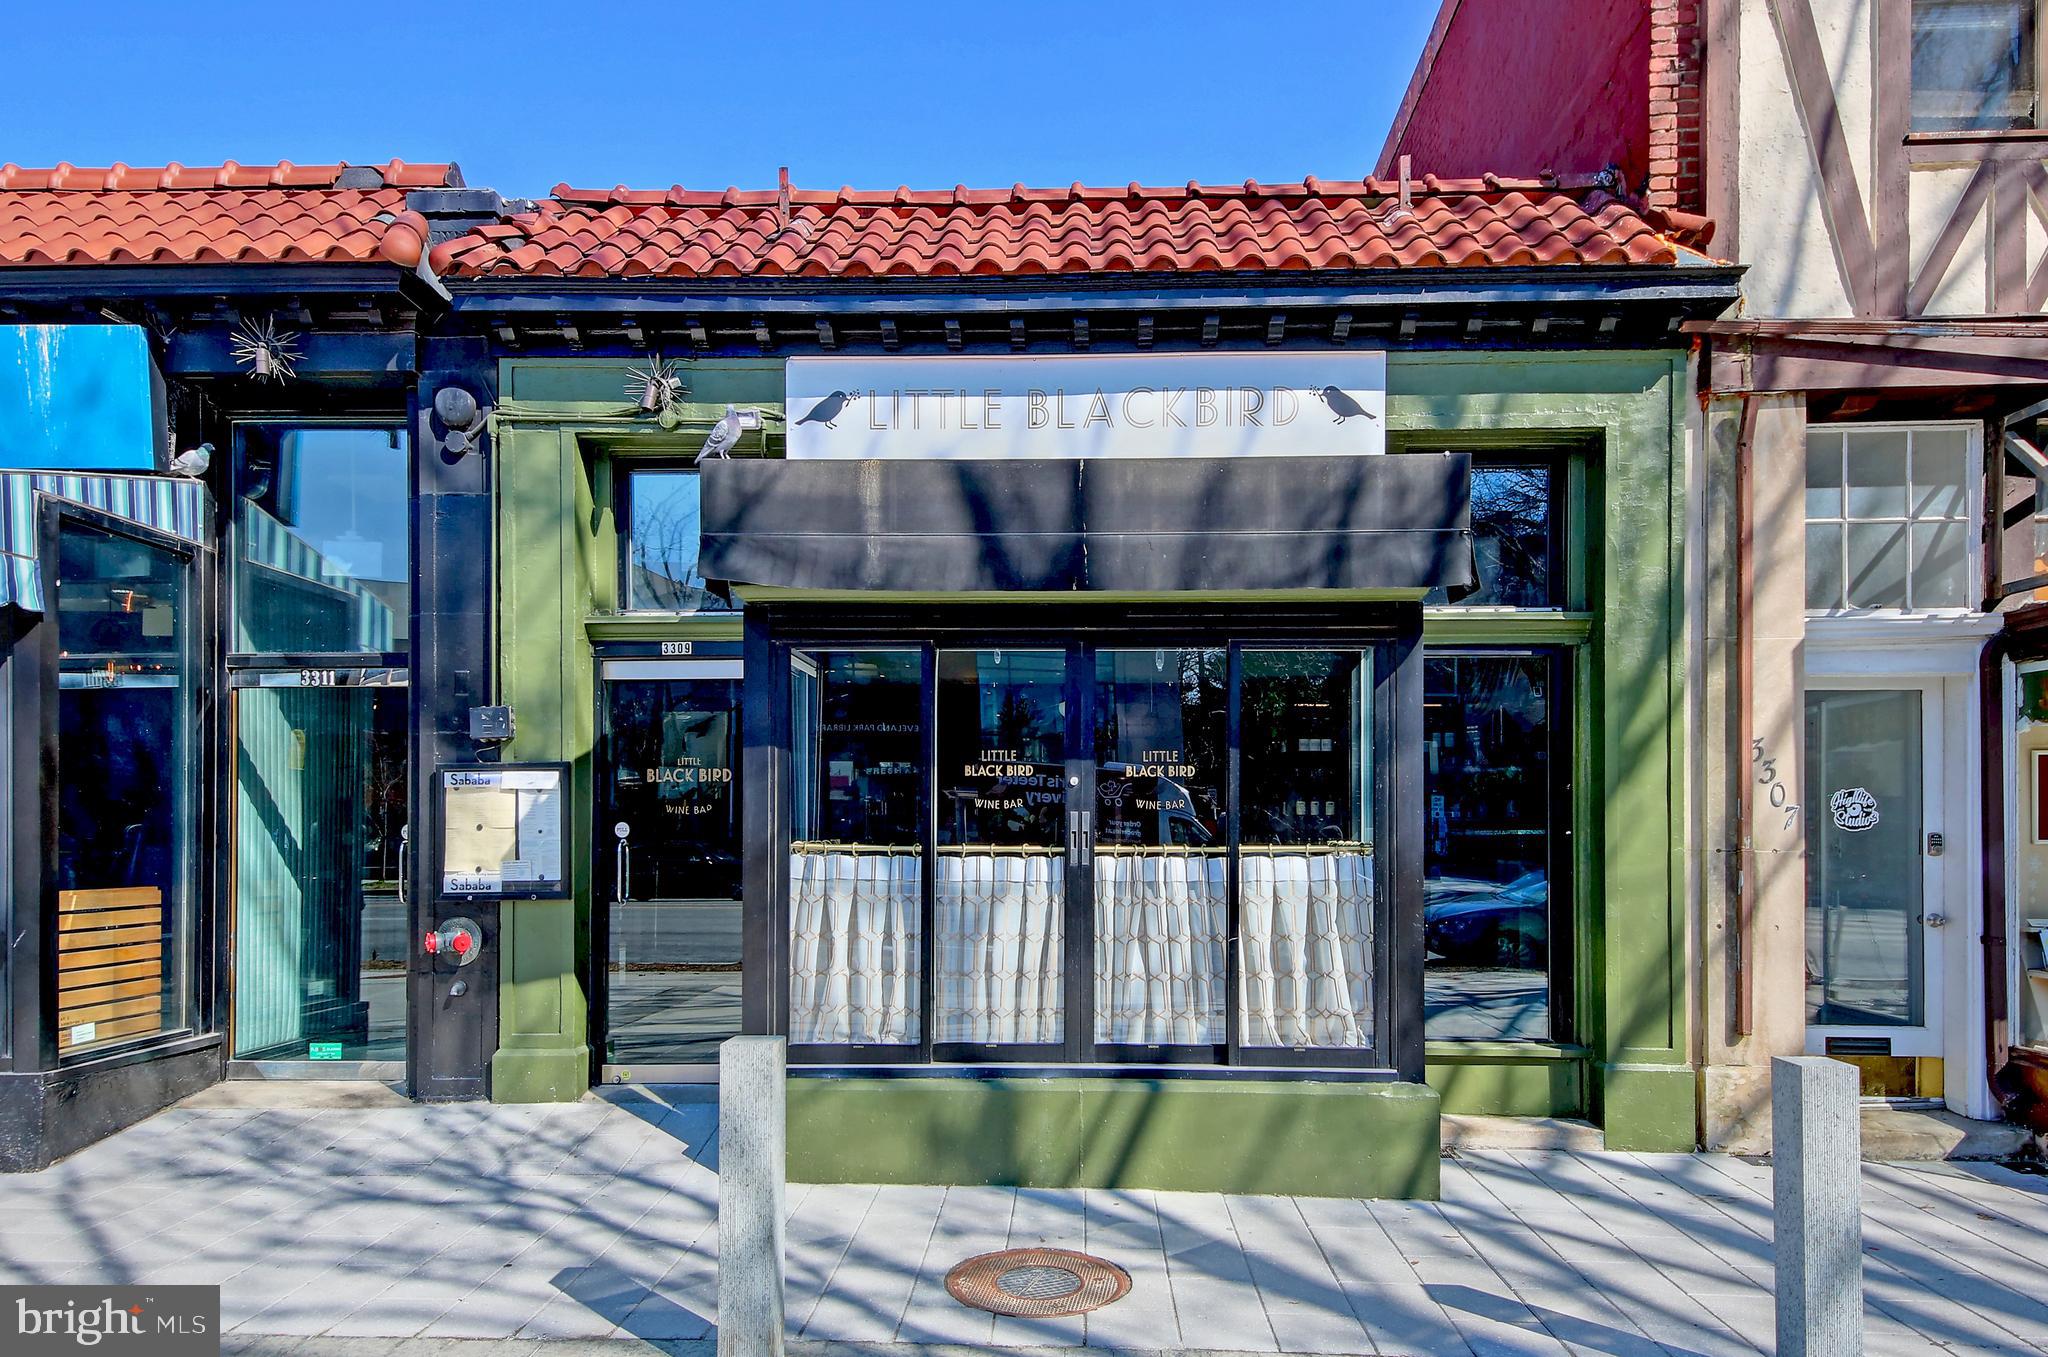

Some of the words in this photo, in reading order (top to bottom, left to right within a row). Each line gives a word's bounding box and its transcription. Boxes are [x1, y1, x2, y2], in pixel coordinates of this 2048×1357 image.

[869, 388, 1002, 430] LITTLE
[1027, 385, 1300, 430] BLACKBIRD
[663, 643, 690, 654] 3309
[301, 669, 336, 687] 3311
[677, 757, 701, 766] LITTLE
[981, 750, 1017, 762] LITTLE
[1142, 750, 1178, 763] LITTLE
[646, 768, 695, 782] BLACK
[698, 768, 732, 782] BIRD
[964, 765, 1002, 777] BLACK
[1006, 765, 1034, 777] BIRD
[1125, 765, 1165, 778] BLACK
[1168, 765, 1196, 778] BIRD
[450, 773, 491, 786] Sababa
[1752, 737, 1800, 831] 3307
[665, 804, 690, 815] WINE
[974, 798, 1000, 809] WINE
[1003, 798, 1024, 809] BAR
[1135, 798, 1162, 810] WINE
[1165, 798, 1185, 810] BAR
[450, 878, 492, 891] Sababa
